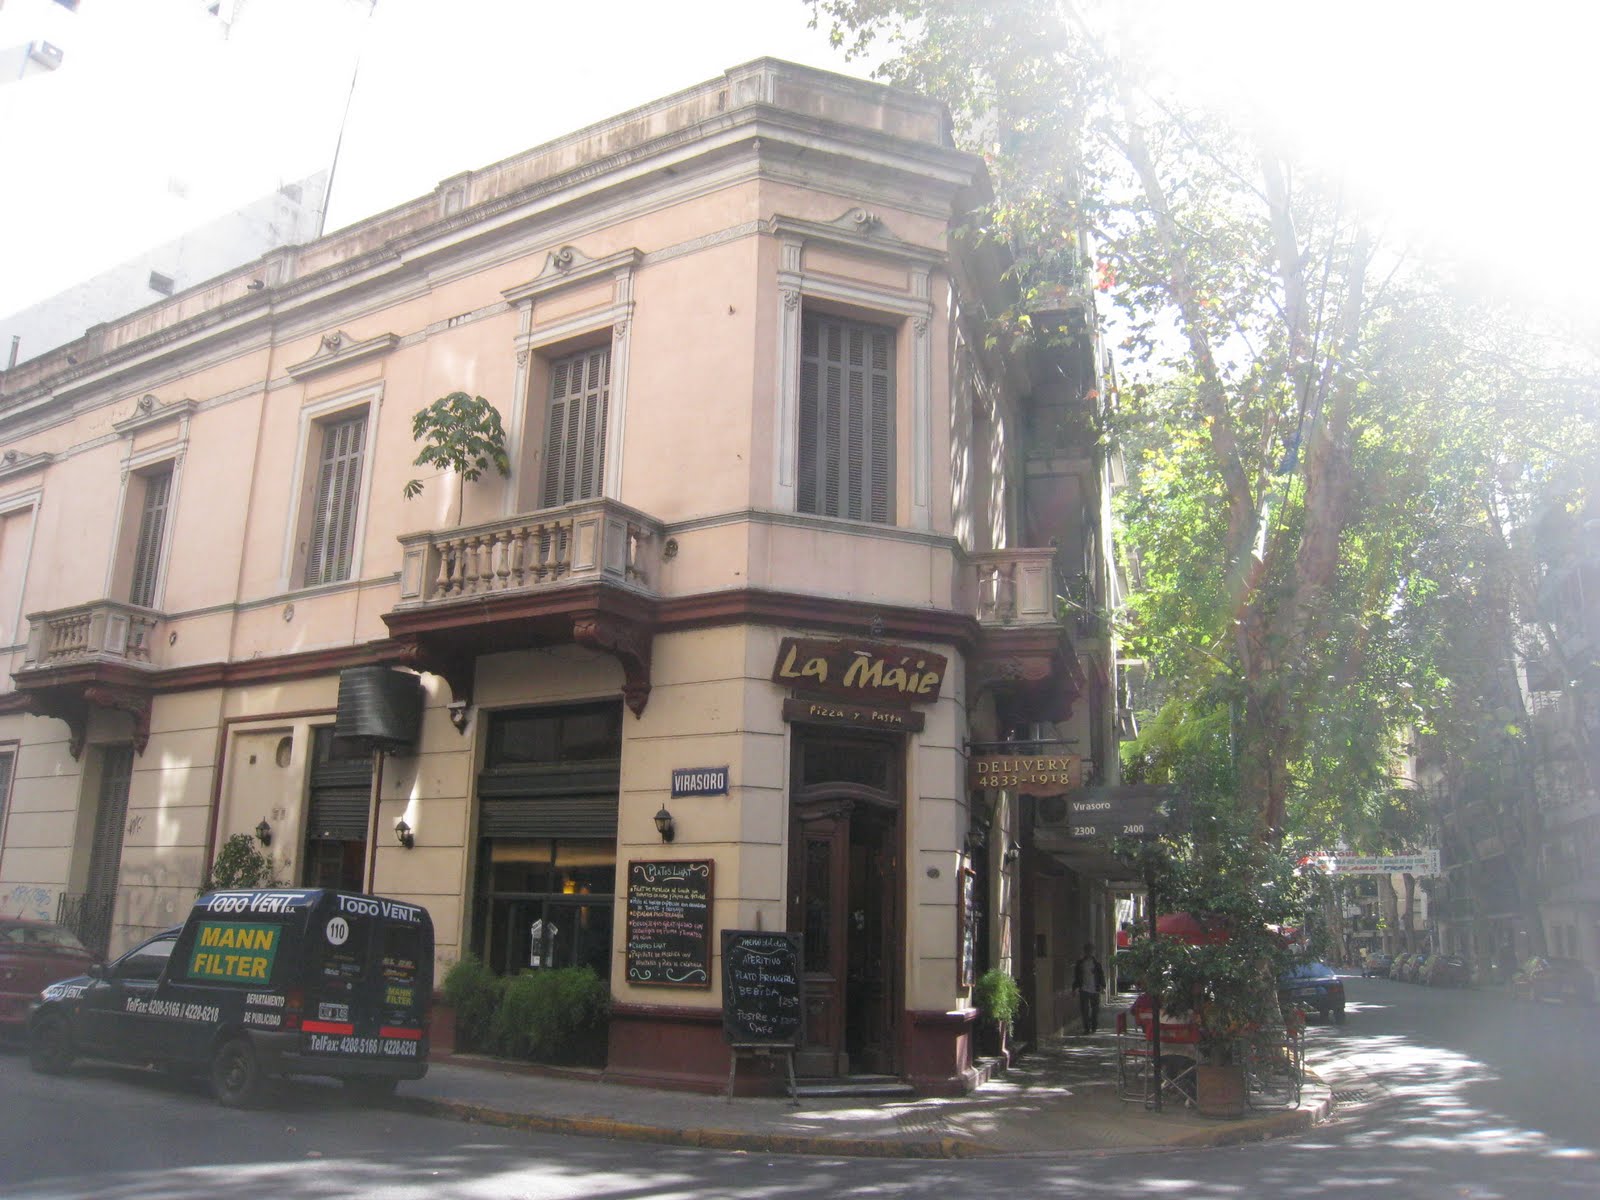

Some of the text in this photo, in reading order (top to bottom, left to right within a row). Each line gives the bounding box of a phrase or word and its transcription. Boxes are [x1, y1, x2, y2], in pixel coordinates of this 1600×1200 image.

[779, 644, 828, 683] La
[809, 705, 844, 718] Pizza
[872, 711, 902, 723] Pasta
[978, 758, 1070, 774] DELIVERY
[674, 773, 724, 791] VIRASORO
[979, 773, 1070, 787] 4833-1918
[1073, 802, 1111, 811] Virasoro
[1074, 825, 1144, 835] 2300 2400
[206, 893, 254, 913] TODO
[250, 893, 306, 913] VENT
[337, 894, 380, 916] TODO
[381, 901, 422, 922] VENT
[200, 927, 274, 950] MANN
[330, 923, 345, 940] 110
[193, 953, 268, 978] FILTER
[742, 953, 781, 965] APERITIVO
[246, 993, 285, 1007] DEPARTAMENTO
[243, 1012, 281, 1026] DE PUBLICIDAD
